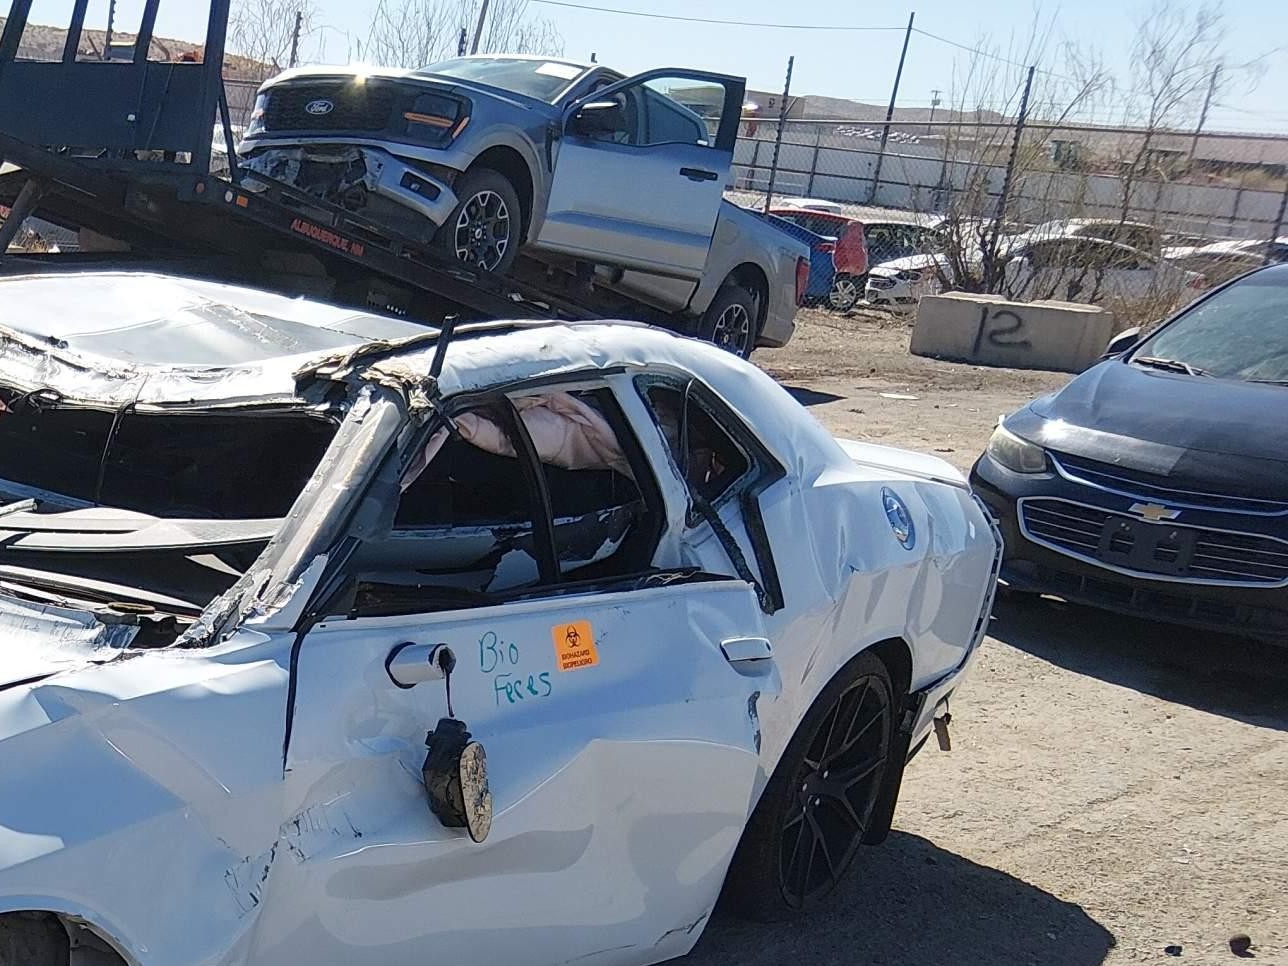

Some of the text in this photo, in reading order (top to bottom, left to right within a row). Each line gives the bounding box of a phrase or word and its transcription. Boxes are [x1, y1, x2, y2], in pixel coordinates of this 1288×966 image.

[969, 307, 1032, 356] 12
[479, 631, 519, 673] Bio
[561, 649, 590, 661] BIOHAZARD
[563, 657, 592, 669] BIOPELIGRO
